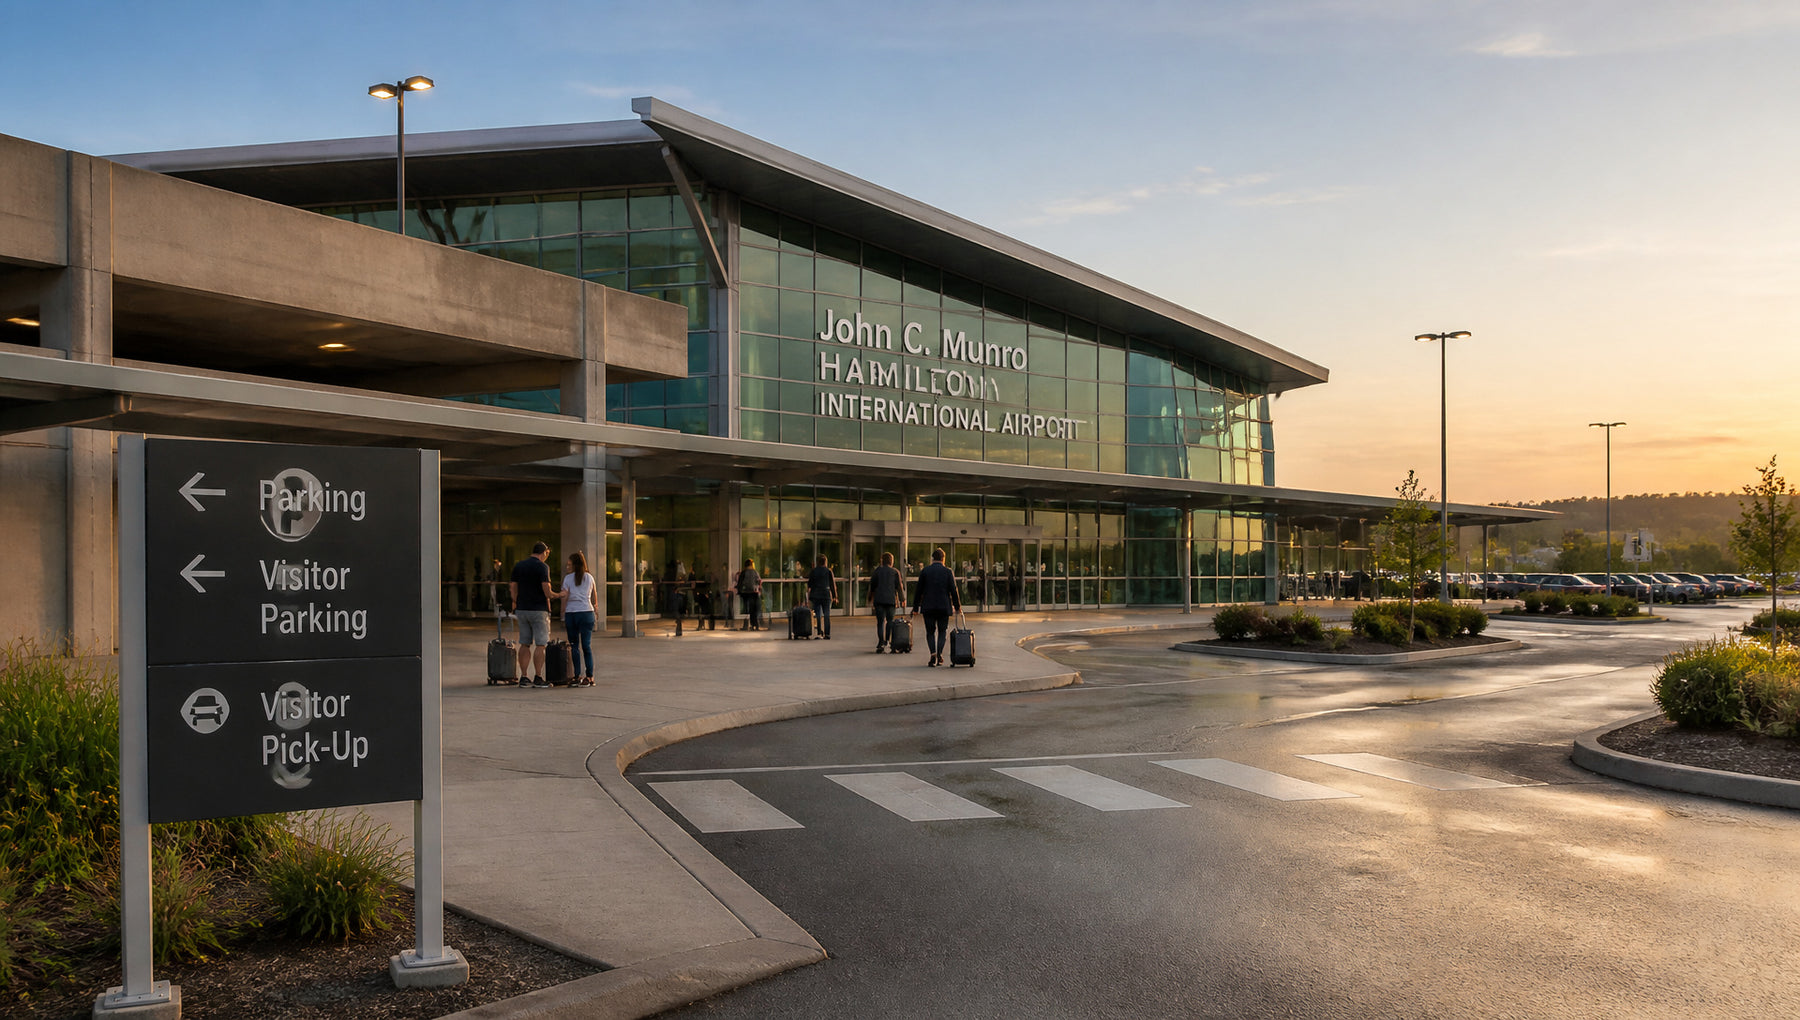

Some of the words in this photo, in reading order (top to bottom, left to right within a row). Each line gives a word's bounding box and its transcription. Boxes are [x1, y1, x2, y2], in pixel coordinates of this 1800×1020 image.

[820, 309, 892, 349] John
[904, 322, 930, 355] C.
[943, 328, 1028, 370] Munro
[819, 392, 996, 433] INTERNATIONAL
[259, 479, 366, 521] Parking
[259, 559, 350, 591] Visitor
[261, 602, 368, 640] Parking
[260, 689, 351, 721] Visitor
[262, 730, 369, 768] Pick-Up
